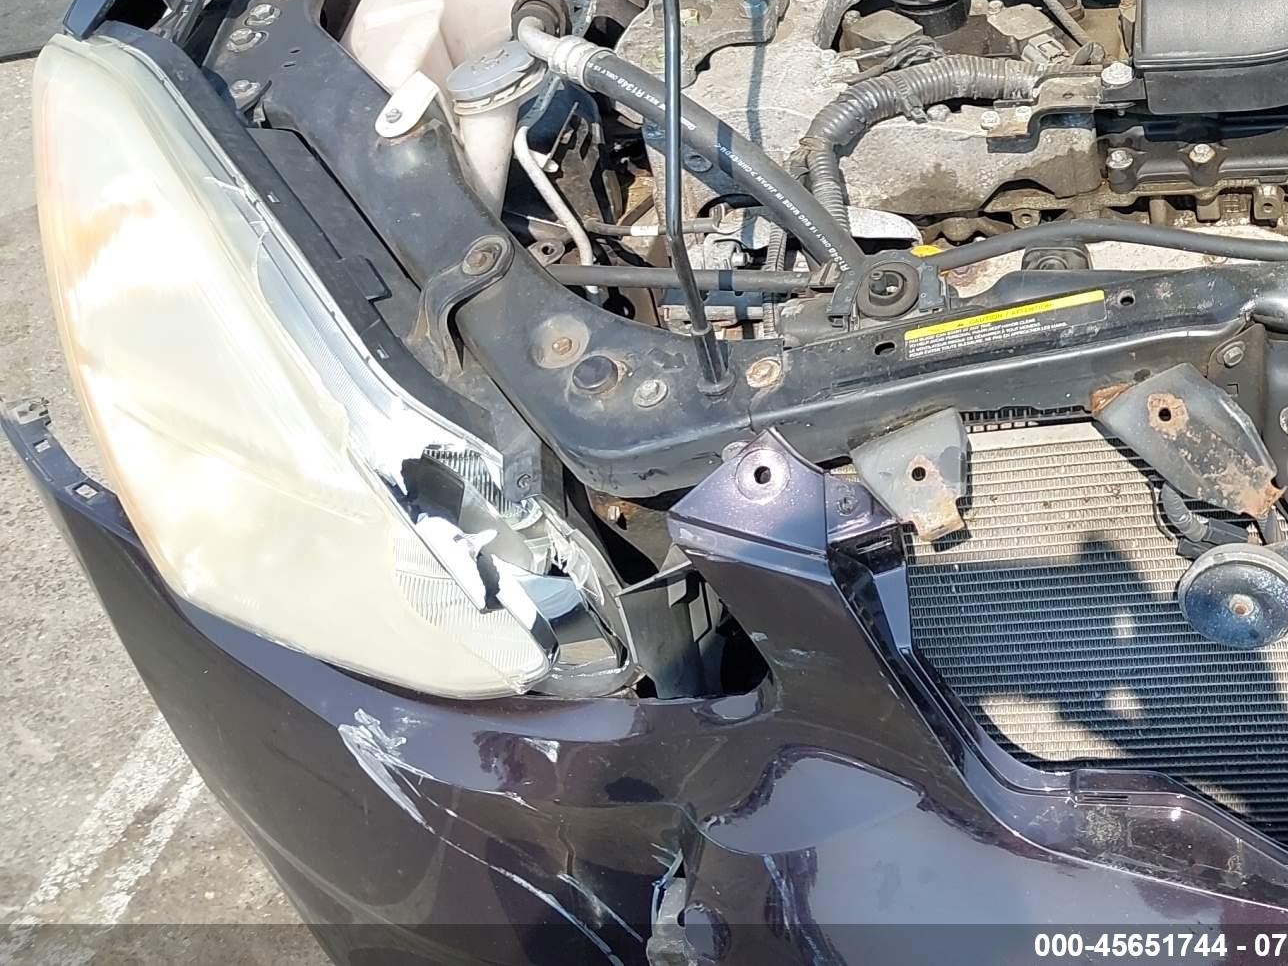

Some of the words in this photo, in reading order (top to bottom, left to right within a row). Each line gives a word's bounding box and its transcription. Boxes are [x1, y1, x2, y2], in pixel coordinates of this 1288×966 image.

[617, 77, 646, 98] R134a
[755, 175, 777, 194] JAPAN
[969, 313, 1003, 325] CAUTION
[1011, 303, 1052, 315] ATTENTION
